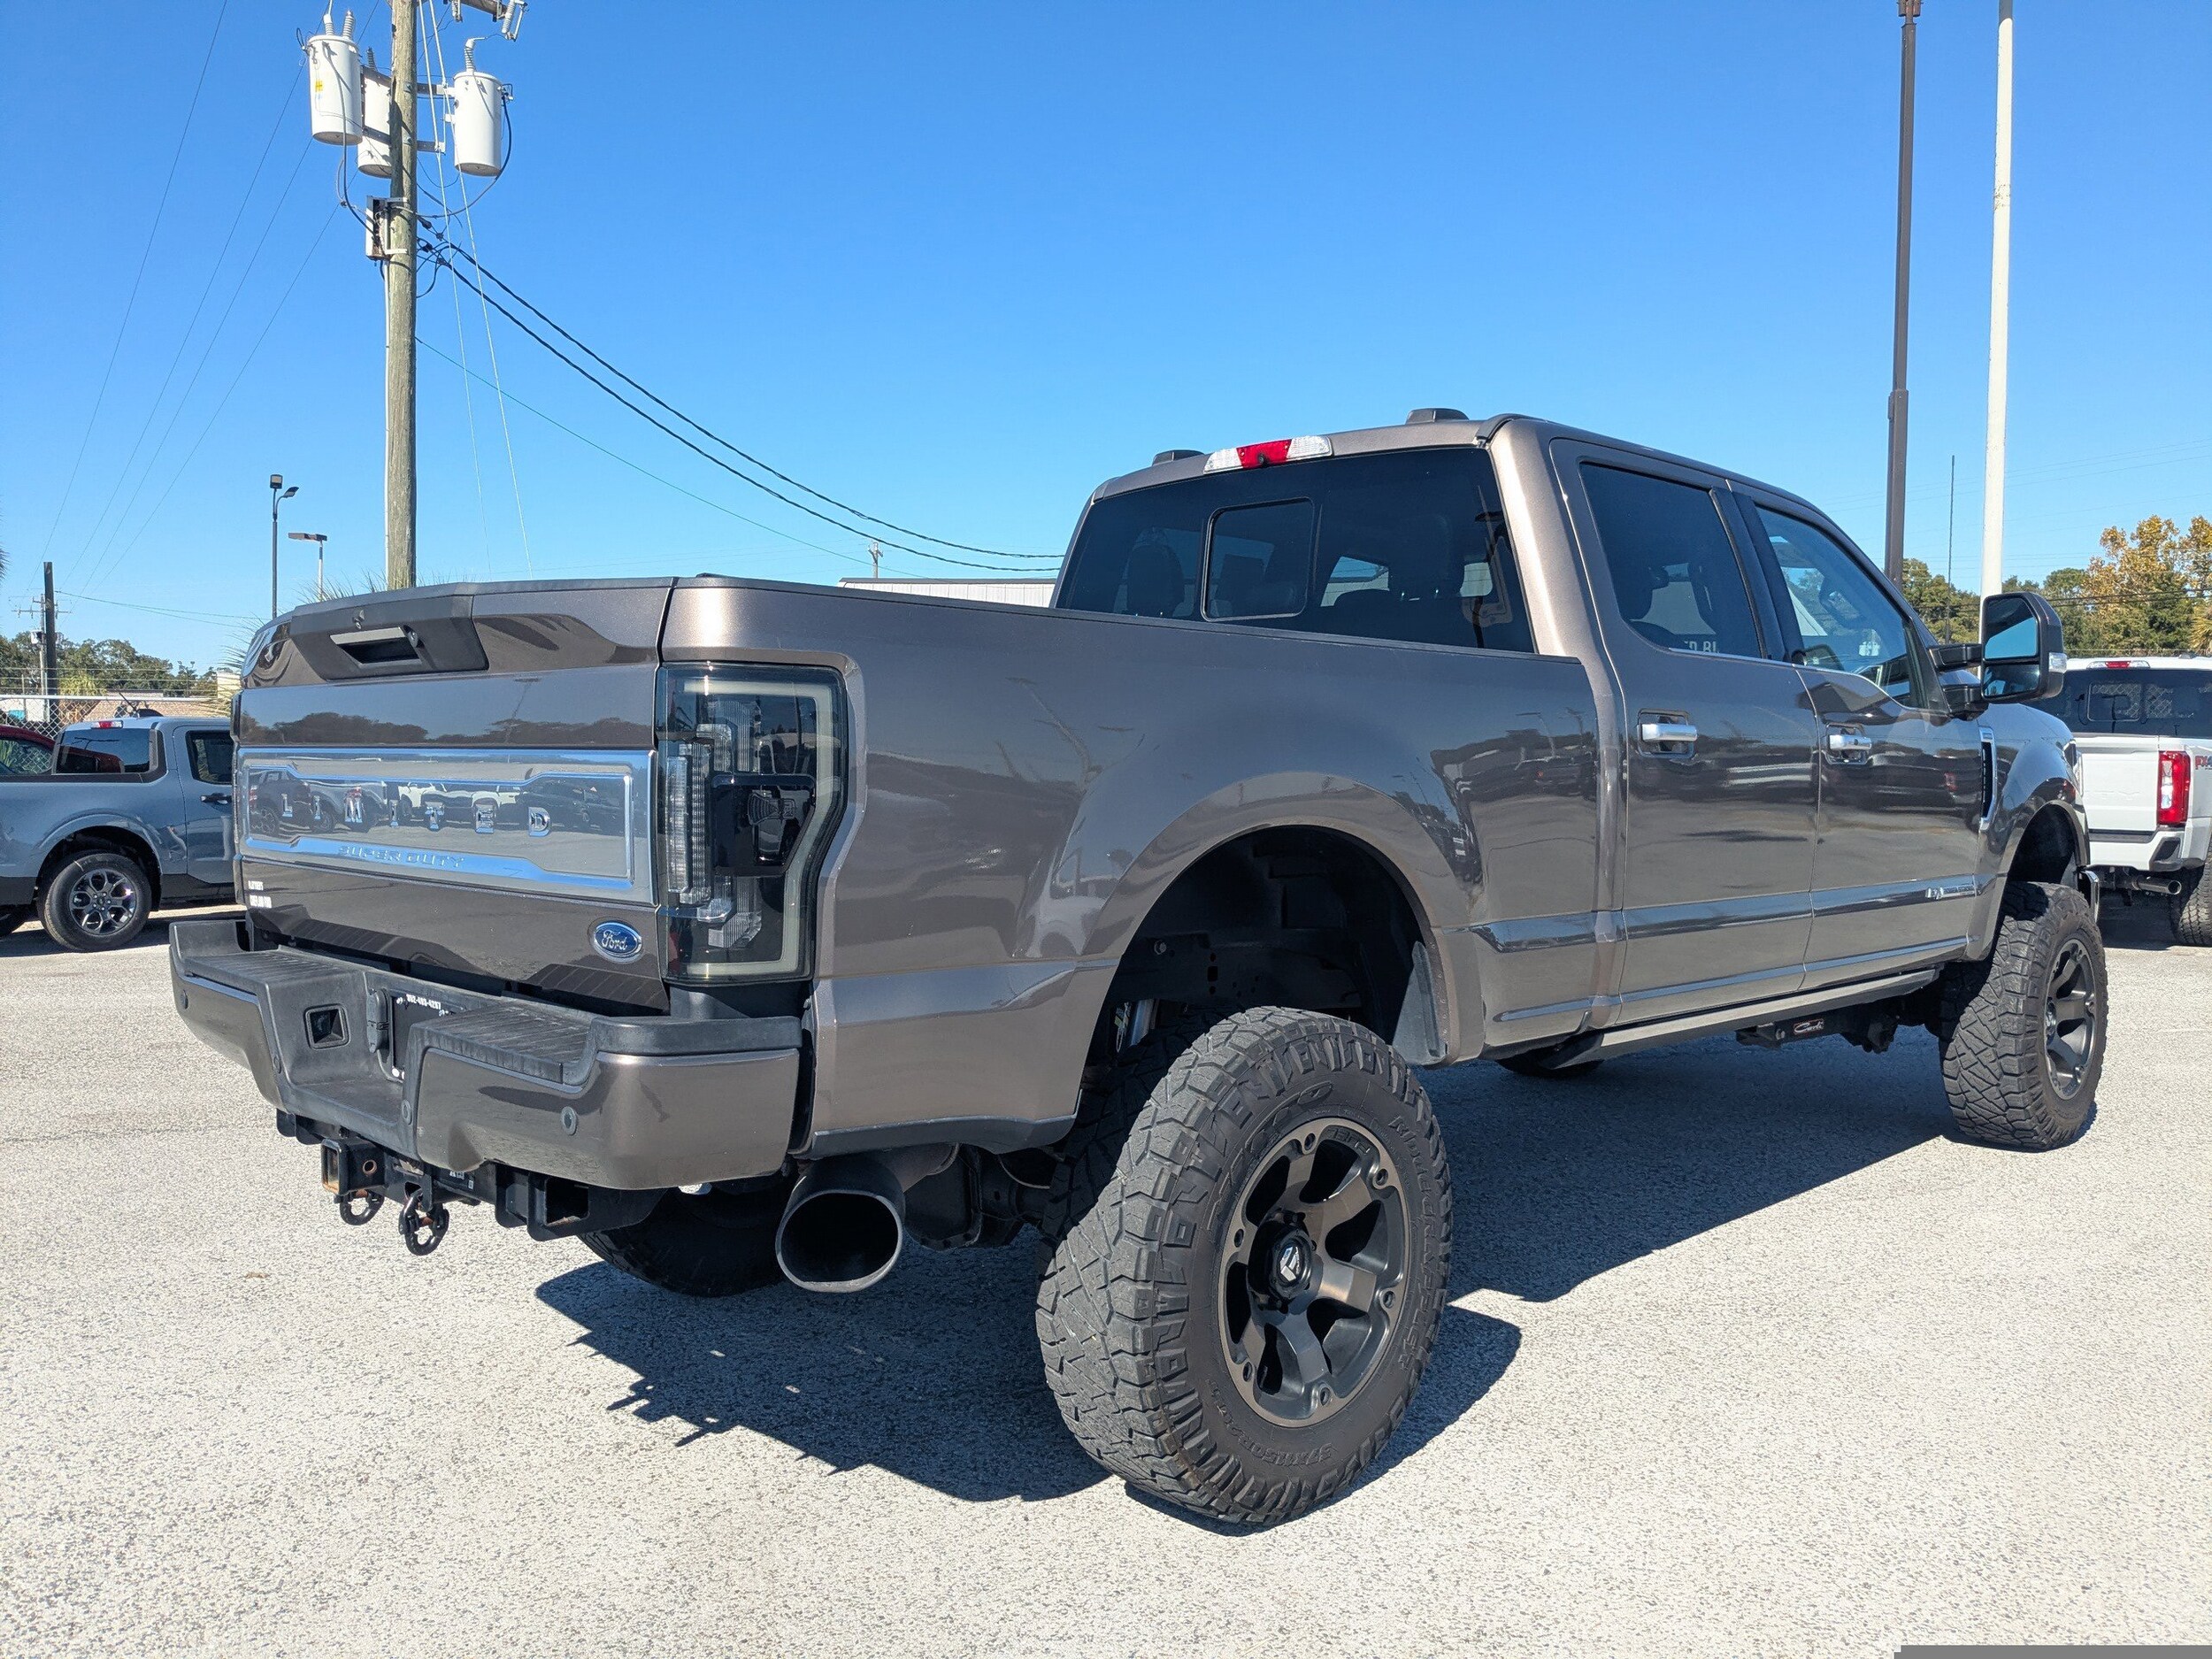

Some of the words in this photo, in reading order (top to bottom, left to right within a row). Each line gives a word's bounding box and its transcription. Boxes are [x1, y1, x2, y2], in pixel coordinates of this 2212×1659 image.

[281, 793, 550, 836] LIMITED
[338, 846, 402, 862] SUPER
[406, 852, 465, 868] DUTY
[602, 929, 628, 950] Ford
